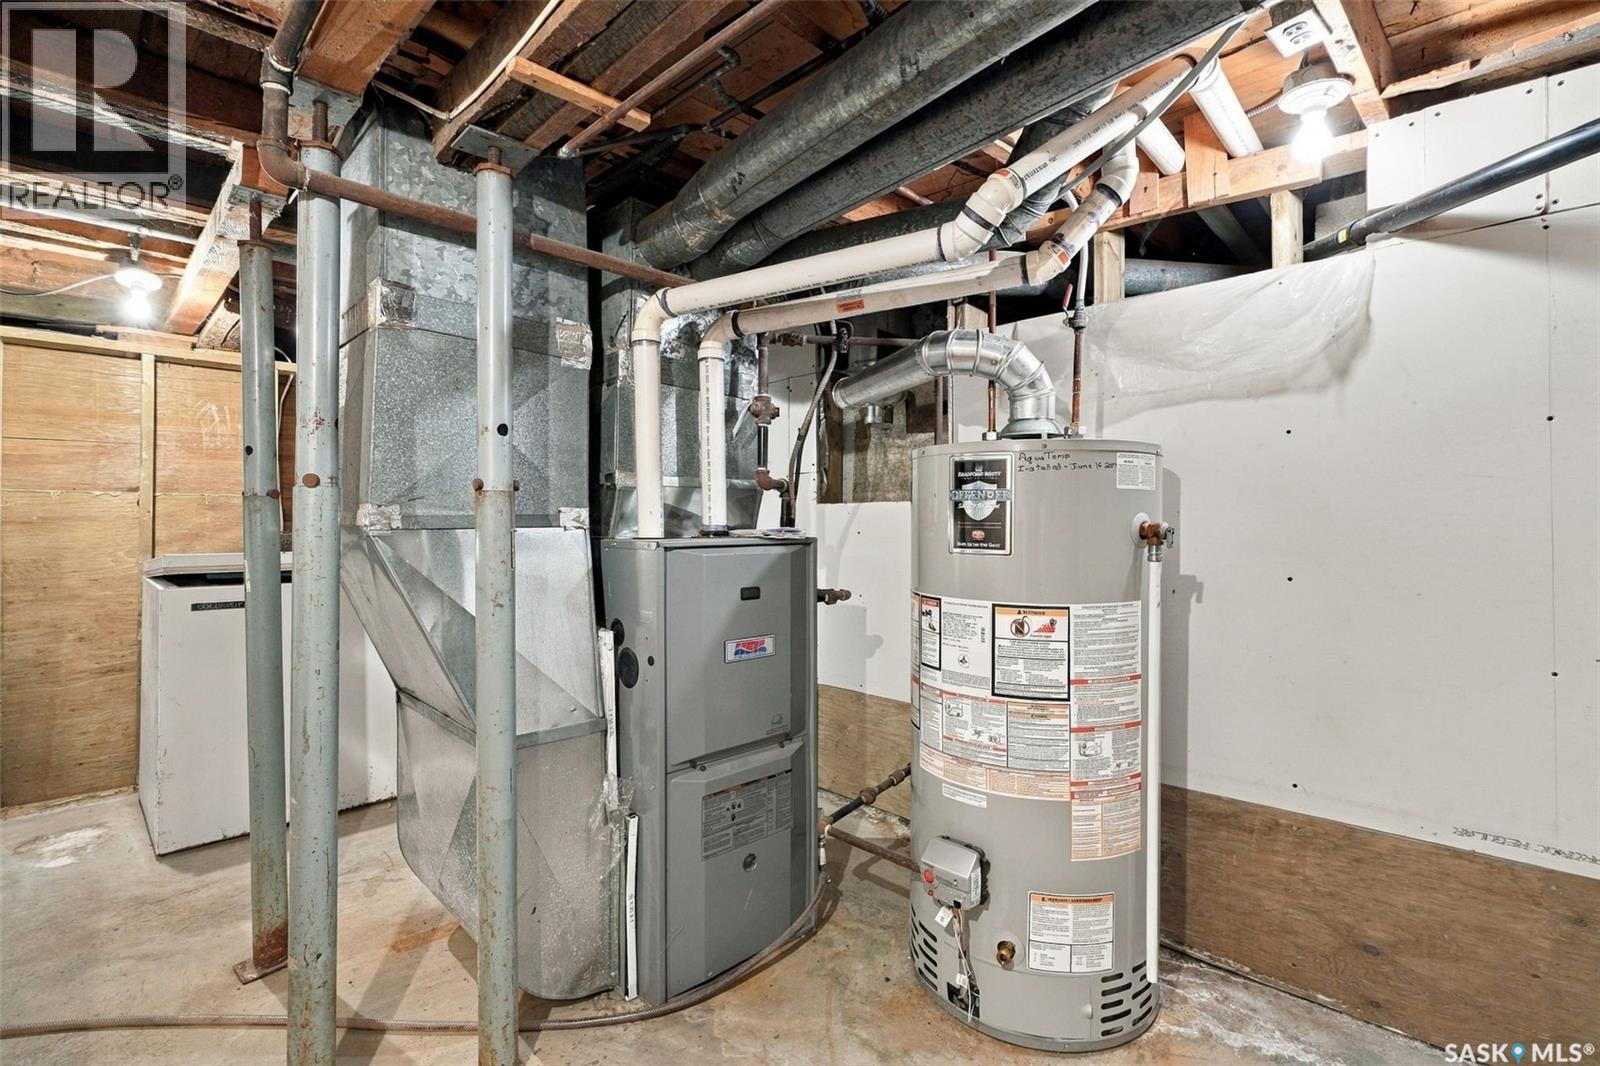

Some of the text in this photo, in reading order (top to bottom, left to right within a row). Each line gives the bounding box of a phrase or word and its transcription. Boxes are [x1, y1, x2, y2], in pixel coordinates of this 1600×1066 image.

[1017, 463, 1062, 472] Installed
[1069, 462, 1093, 471] June
[950, 489, 1011, 501] DEFENDER
